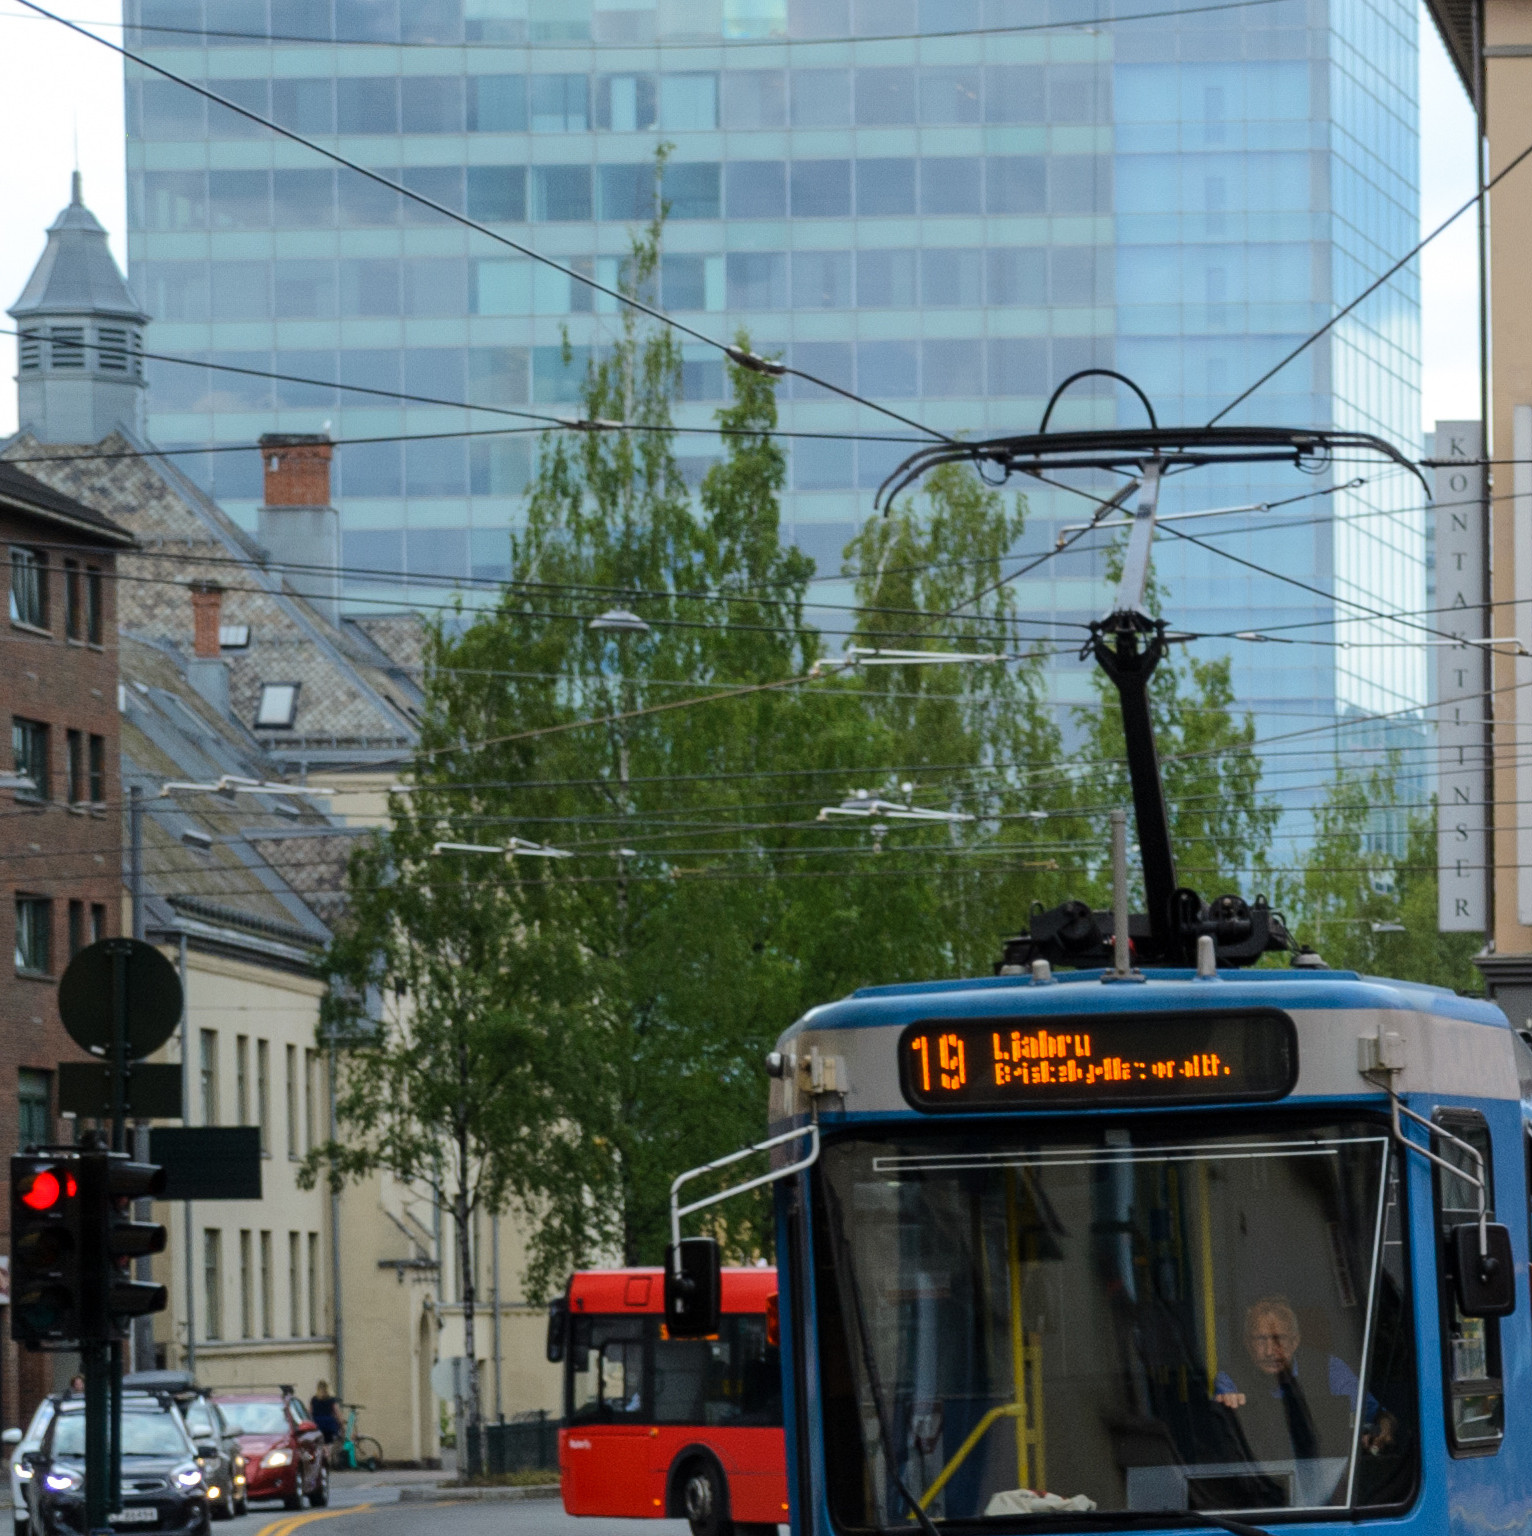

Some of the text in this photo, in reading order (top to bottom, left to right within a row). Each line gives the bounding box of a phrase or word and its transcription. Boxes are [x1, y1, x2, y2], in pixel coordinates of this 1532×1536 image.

[1449, 437, 1471, 918] KONTAKTLINSER
[911, 1029, 1092, 1091] 19 Ljabru
